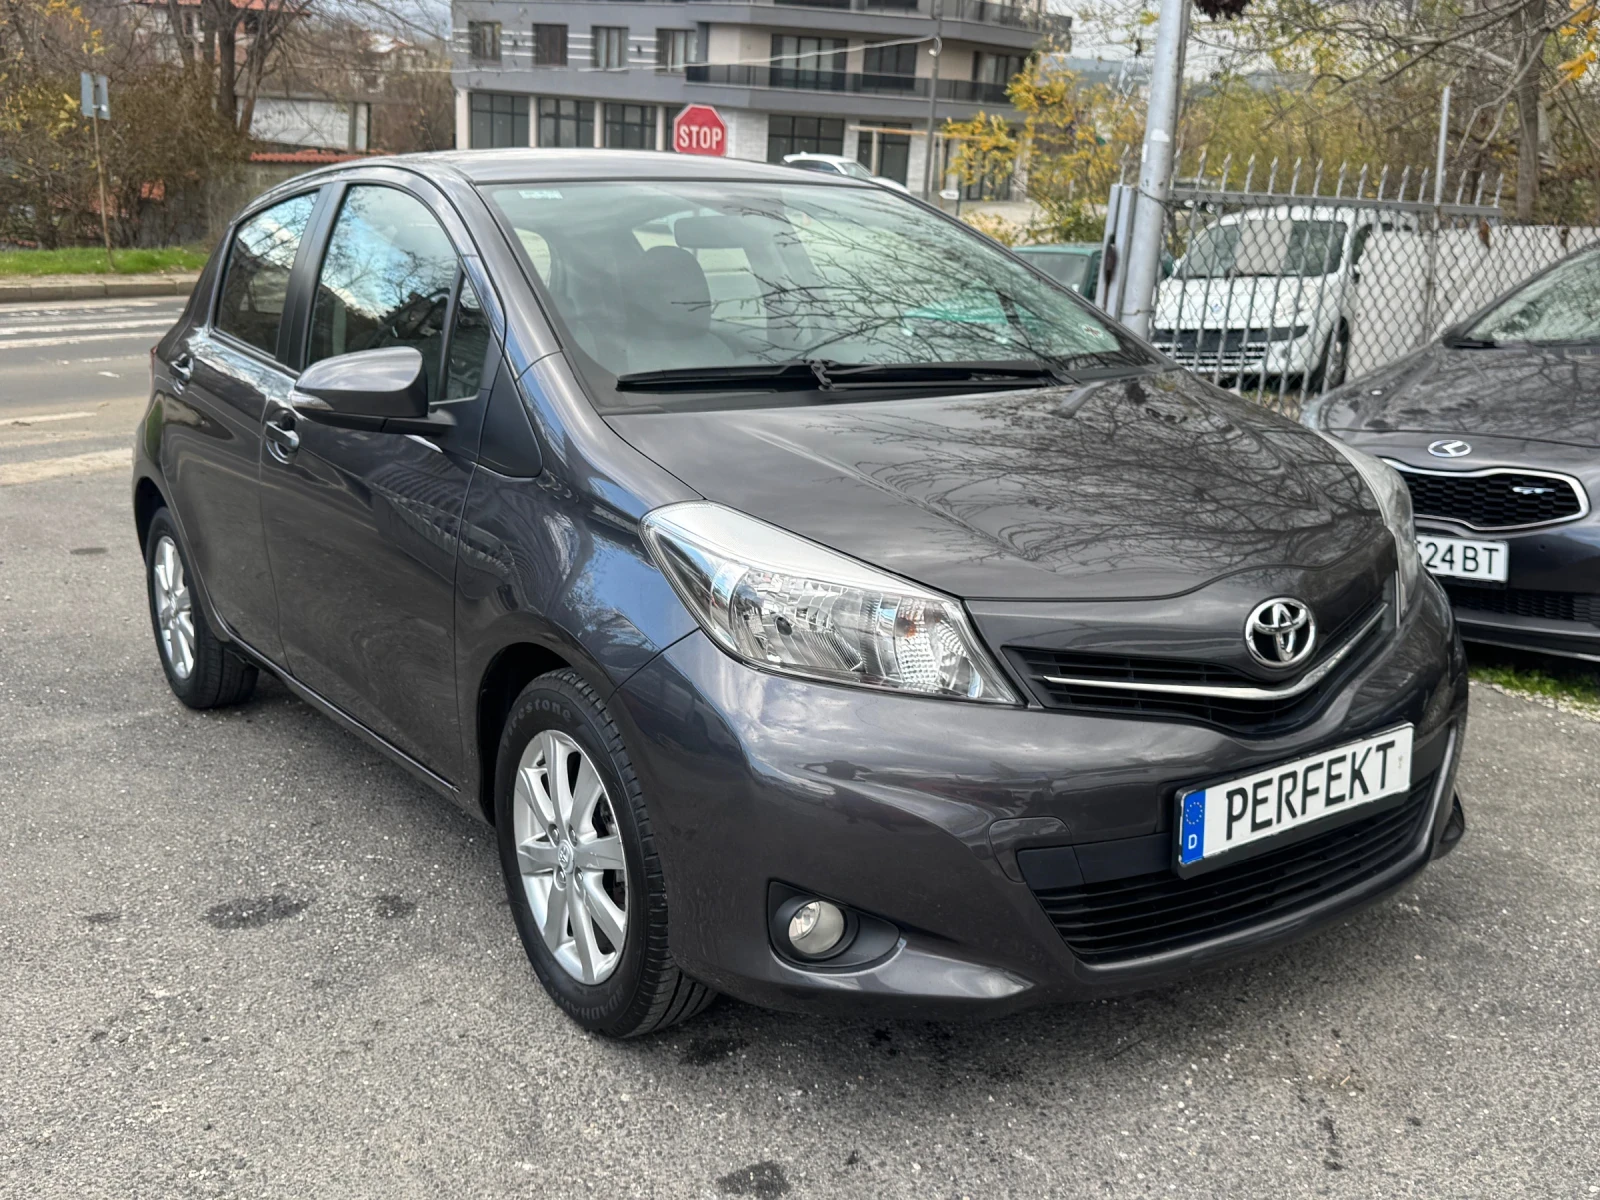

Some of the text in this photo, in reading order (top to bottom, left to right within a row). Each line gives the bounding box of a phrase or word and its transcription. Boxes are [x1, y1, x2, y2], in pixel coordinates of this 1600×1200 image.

[679, 124, 723, 150] STOP
[1226, 740, 1396, 841] PERFEKT
[1188, 834, 1198, 850] D
